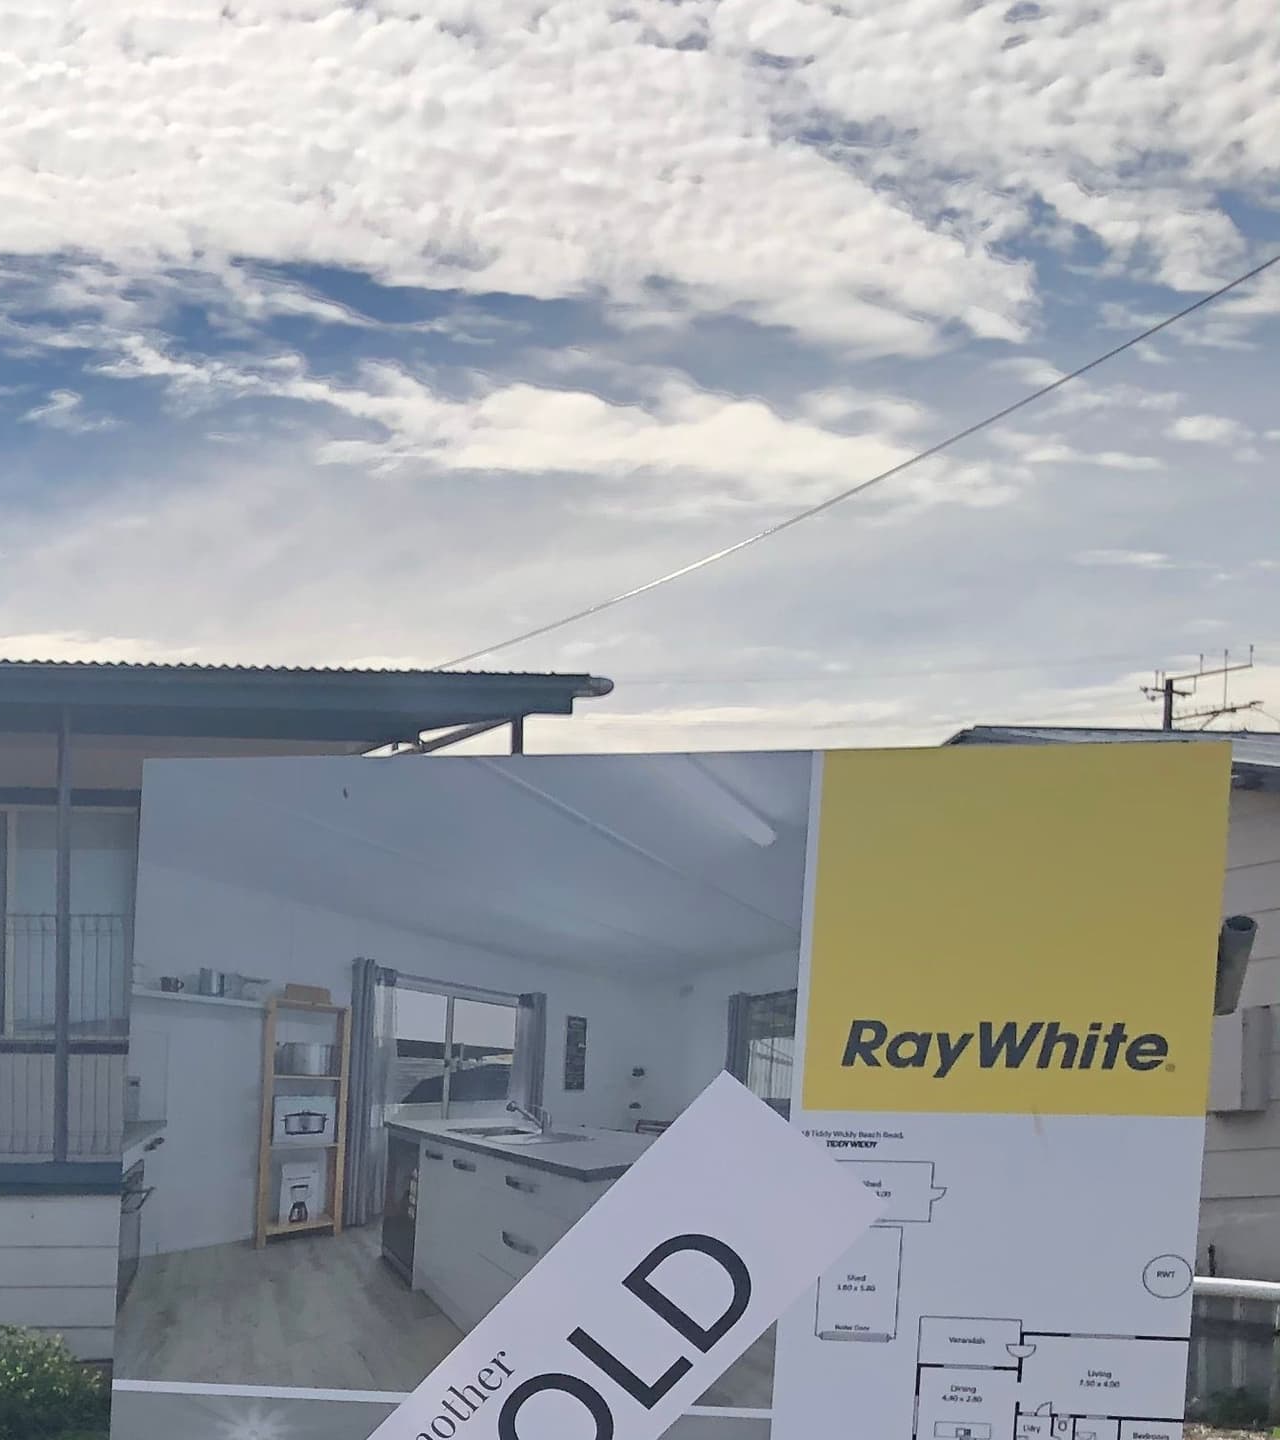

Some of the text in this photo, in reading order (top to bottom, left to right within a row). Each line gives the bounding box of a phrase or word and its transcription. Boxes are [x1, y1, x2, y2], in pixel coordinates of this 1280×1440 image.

[840, 1020, 1170, 1079] RayWhite
[1156, 1270, 1175, 1278] RWT
[1088, 1370, 1112, 1379] Living
